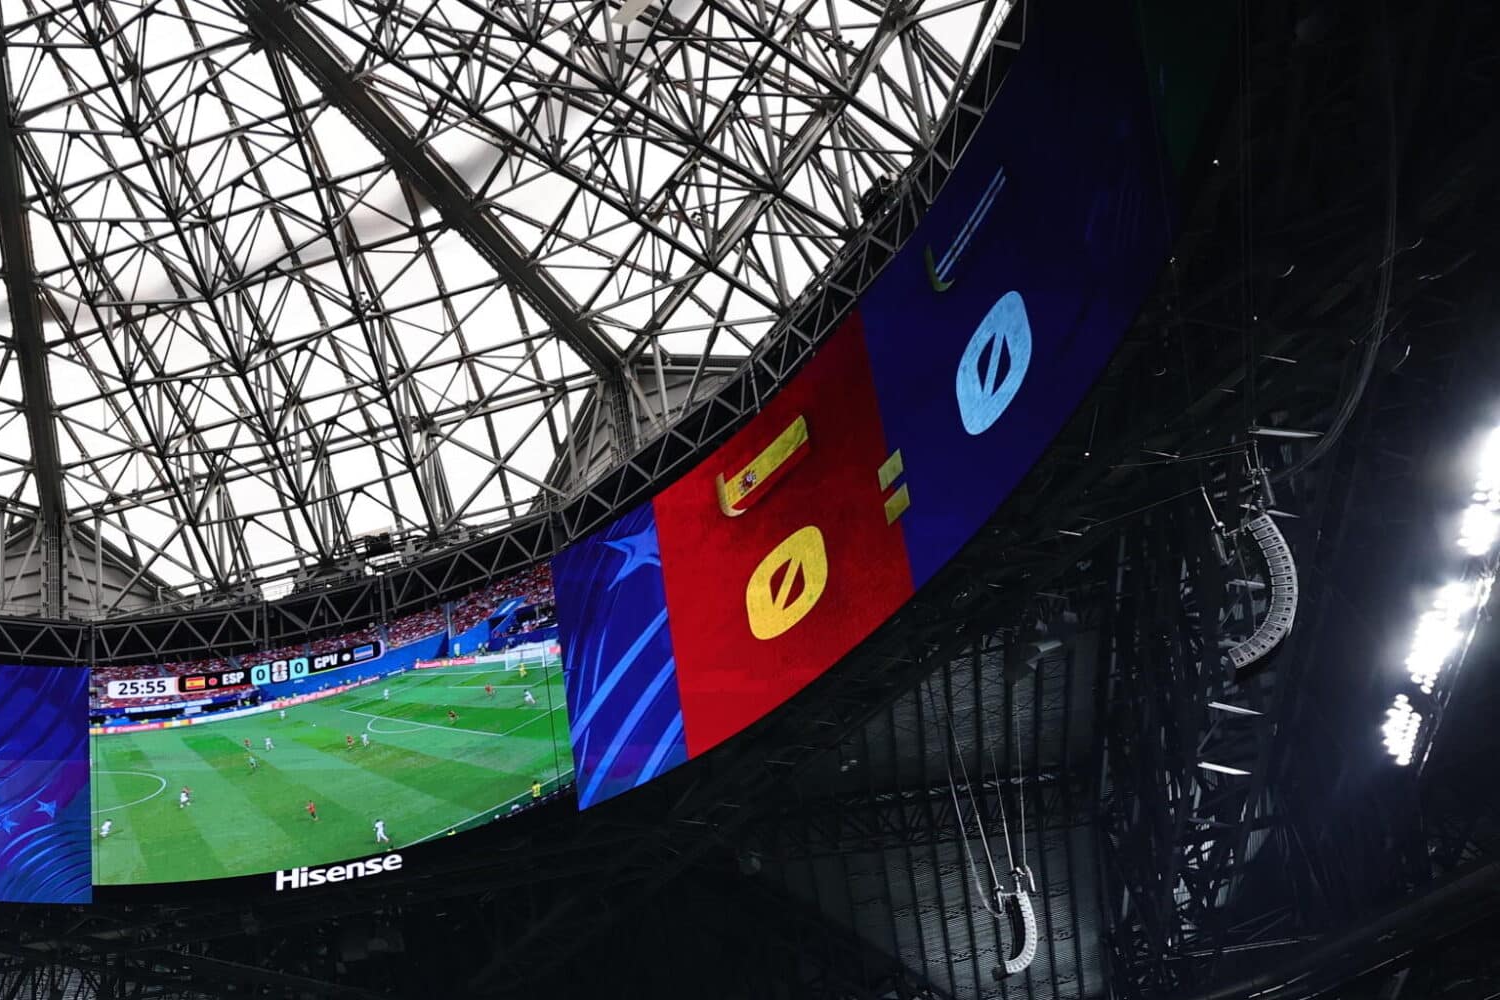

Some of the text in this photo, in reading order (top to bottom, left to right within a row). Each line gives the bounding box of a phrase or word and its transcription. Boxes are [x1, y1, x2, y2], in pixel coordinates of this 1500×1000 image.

[294, 662, 304, 674] 0
[314, 653, 338, 669] CPV
[222, 671, 244, 686] ESP
[256, 669, 266, 681] 0
[118, 680, 166, 695] 25:55
[275, 853, 403, 891] Hisense
